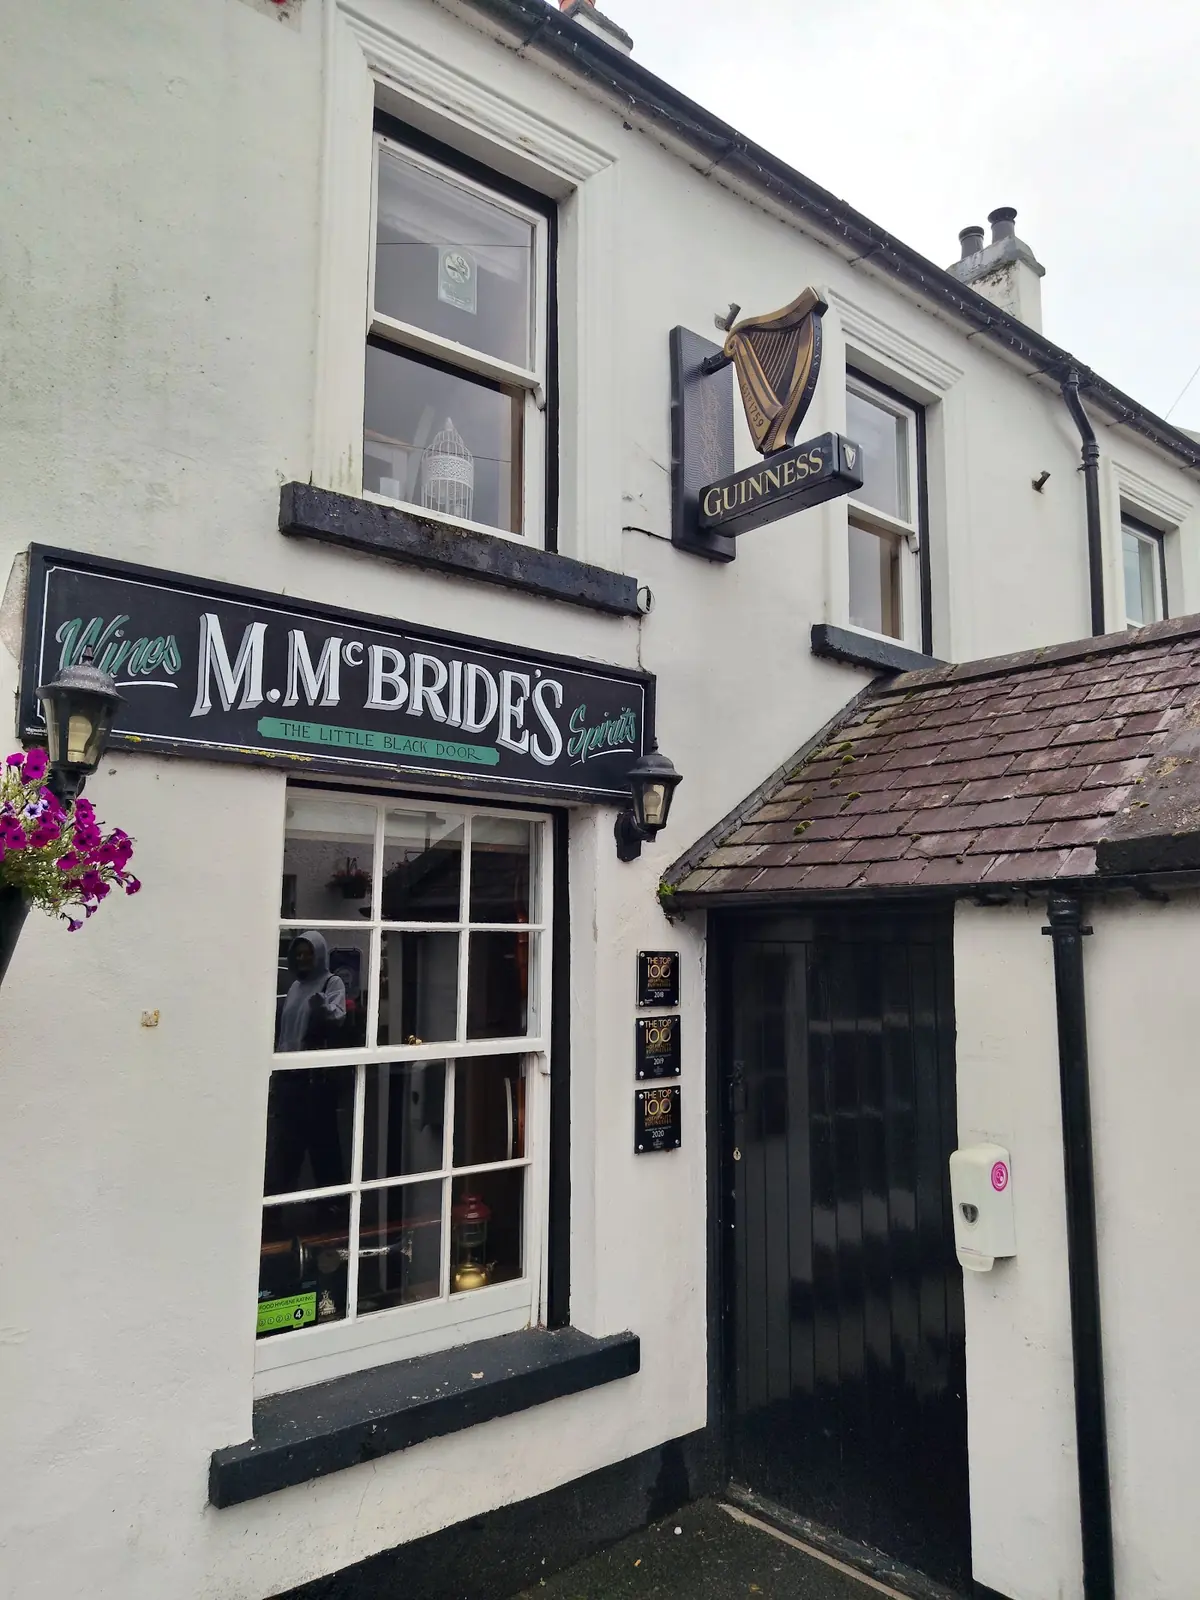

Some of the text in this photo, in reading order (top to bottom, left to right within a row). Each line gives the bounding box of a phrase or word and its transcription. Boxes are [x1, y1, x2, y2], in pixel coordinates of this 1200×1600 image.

[749, 401, 764, 427] 1759
[703, 447, 823, 517] GUINNESS
[55, 615, 181, 678] Wines
[567, 703, 636, 764] Spirits
[280, 722, 482, 761] THE LITTLE BLACK DOOR
[659, 956, 671, 964] TOP
[647, 964, 671, 978] 100
[644, 1019, 671, 1028] THE TOP
[645, 1028, 671, 1043] 100
[653, 1057, 665, 1066] 2019
[643, 1089, 671, 1099] THE TOP
[644, 1098, 671, 1116] 100
[652, 1130, 664, 1138] 2020
[296, 1295, 313, 1303] RATING
